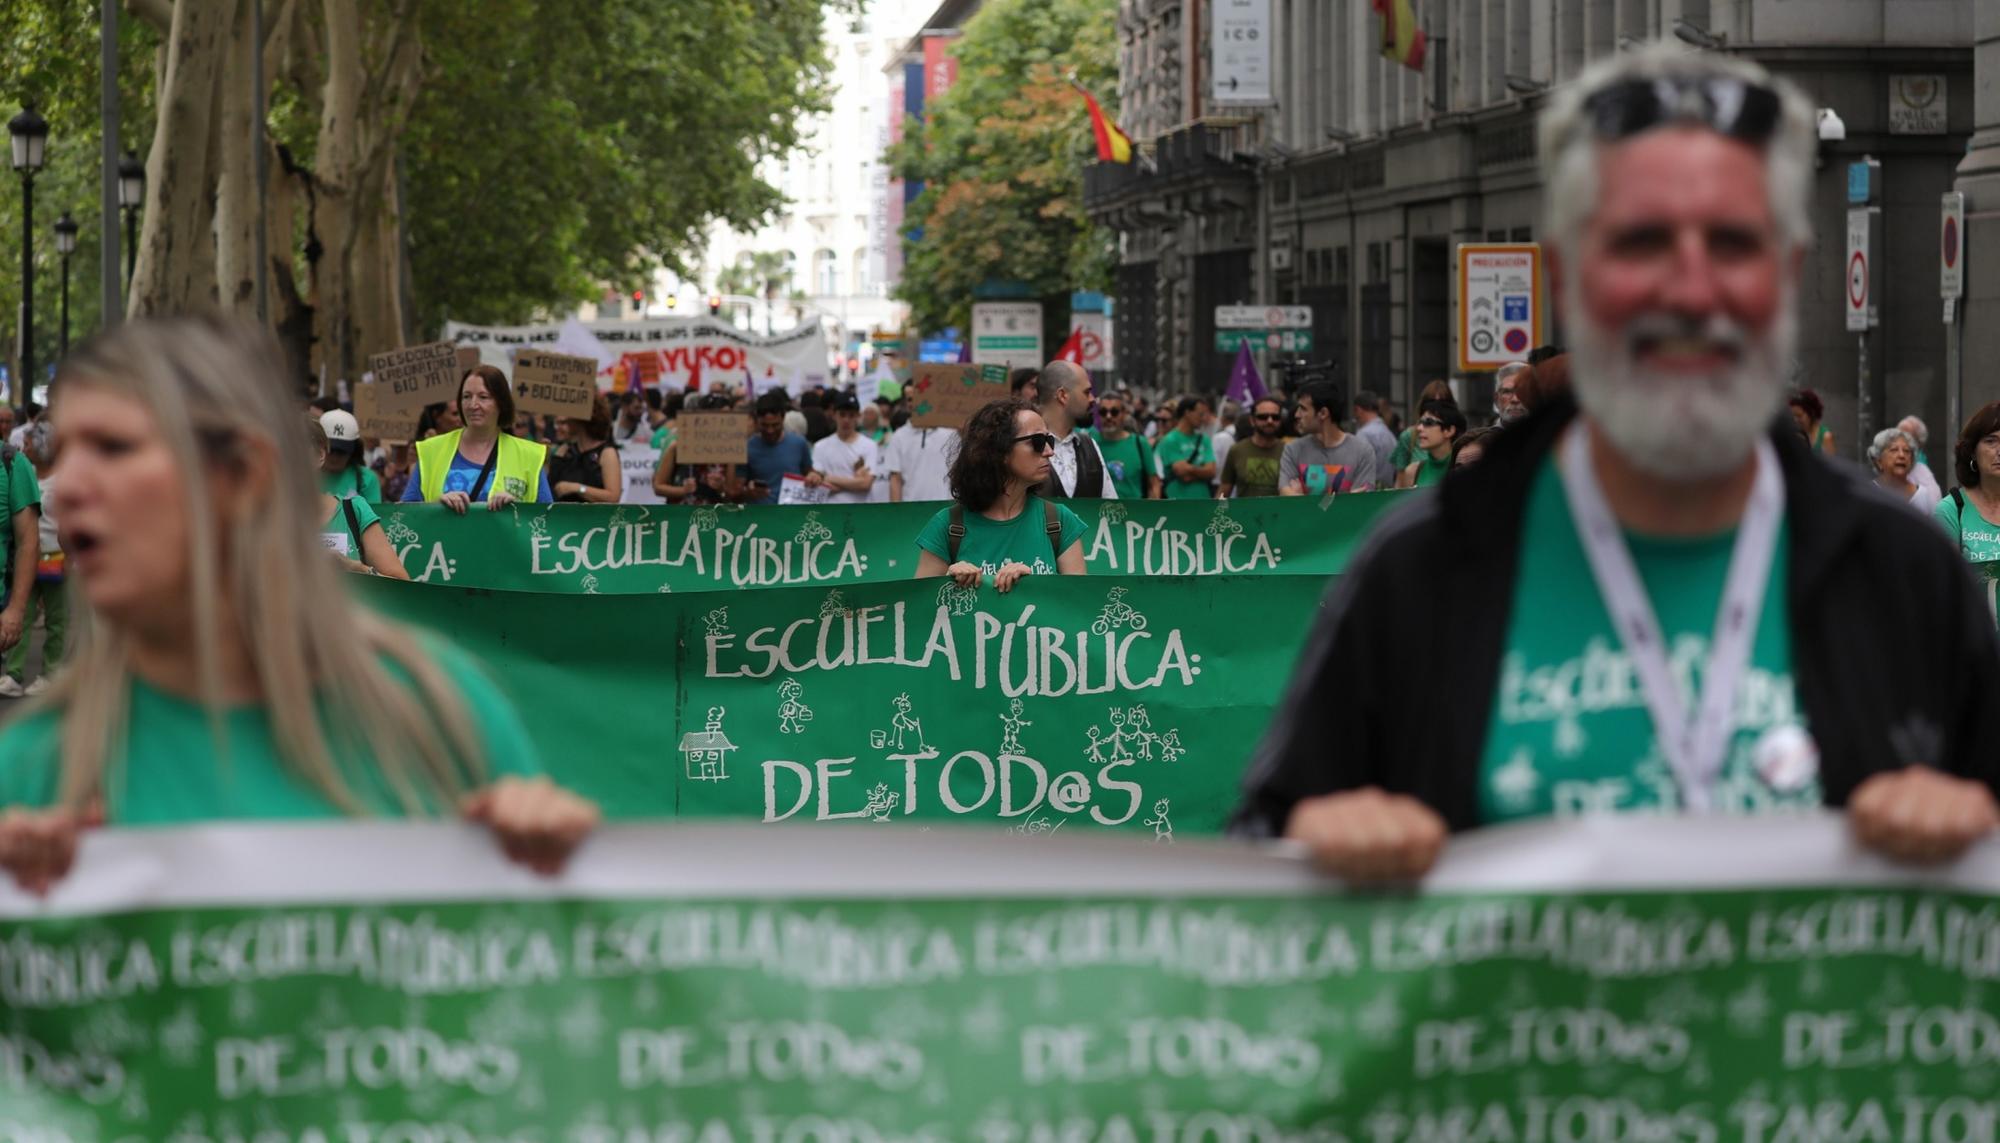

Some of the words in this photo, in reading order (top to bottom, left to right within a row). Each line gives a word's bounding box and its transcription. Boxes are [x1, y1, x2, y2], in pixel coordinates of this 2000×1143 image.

[1224, 28, 1259, 41] ICO
[376, 342, 455, 369] DESDOBLES
[393, 379, 418, 394] BIO
[655, 347, 746, 373] YUSO!
[531, 520, 706, 575] ESCUELA
[714, 522, 868, 586] PÚBLICA:
[1127, 515, 1281, 577] PÚBLICA:
[704, 600, 962, 681] ESCUELA
[975, 604, 1202, 698] PÚBLICA:
[761, 755, 866, 824] DE
[887, 748, 1142, 825] TOD@S
[170, 911, 388, 987] ESCUELA
[577, 907, 785, 977] ESCUELA
[975, 901, 1184, 976] ESCUELA
[1370, 899, 1573, 971] ESCUELA
[1748, 896, 1946, 968] ESCUELA
[216, 1037, 321, 1099] DE
[317, 1026, 520, 1097] TOD@S
[618, 1026, 728, 1088] DE
[727, 1019, 926, 1090] TOD@S
[1021, 1023, 1132, 1085] DE
[1126, 1015, 1325, 1088] TOD@S
[1415, 1017, 1511, 1076] DE
[1508, 1007, 1691, 1072] TOD@S
[1783, 1012, 1889, 1069] DE
